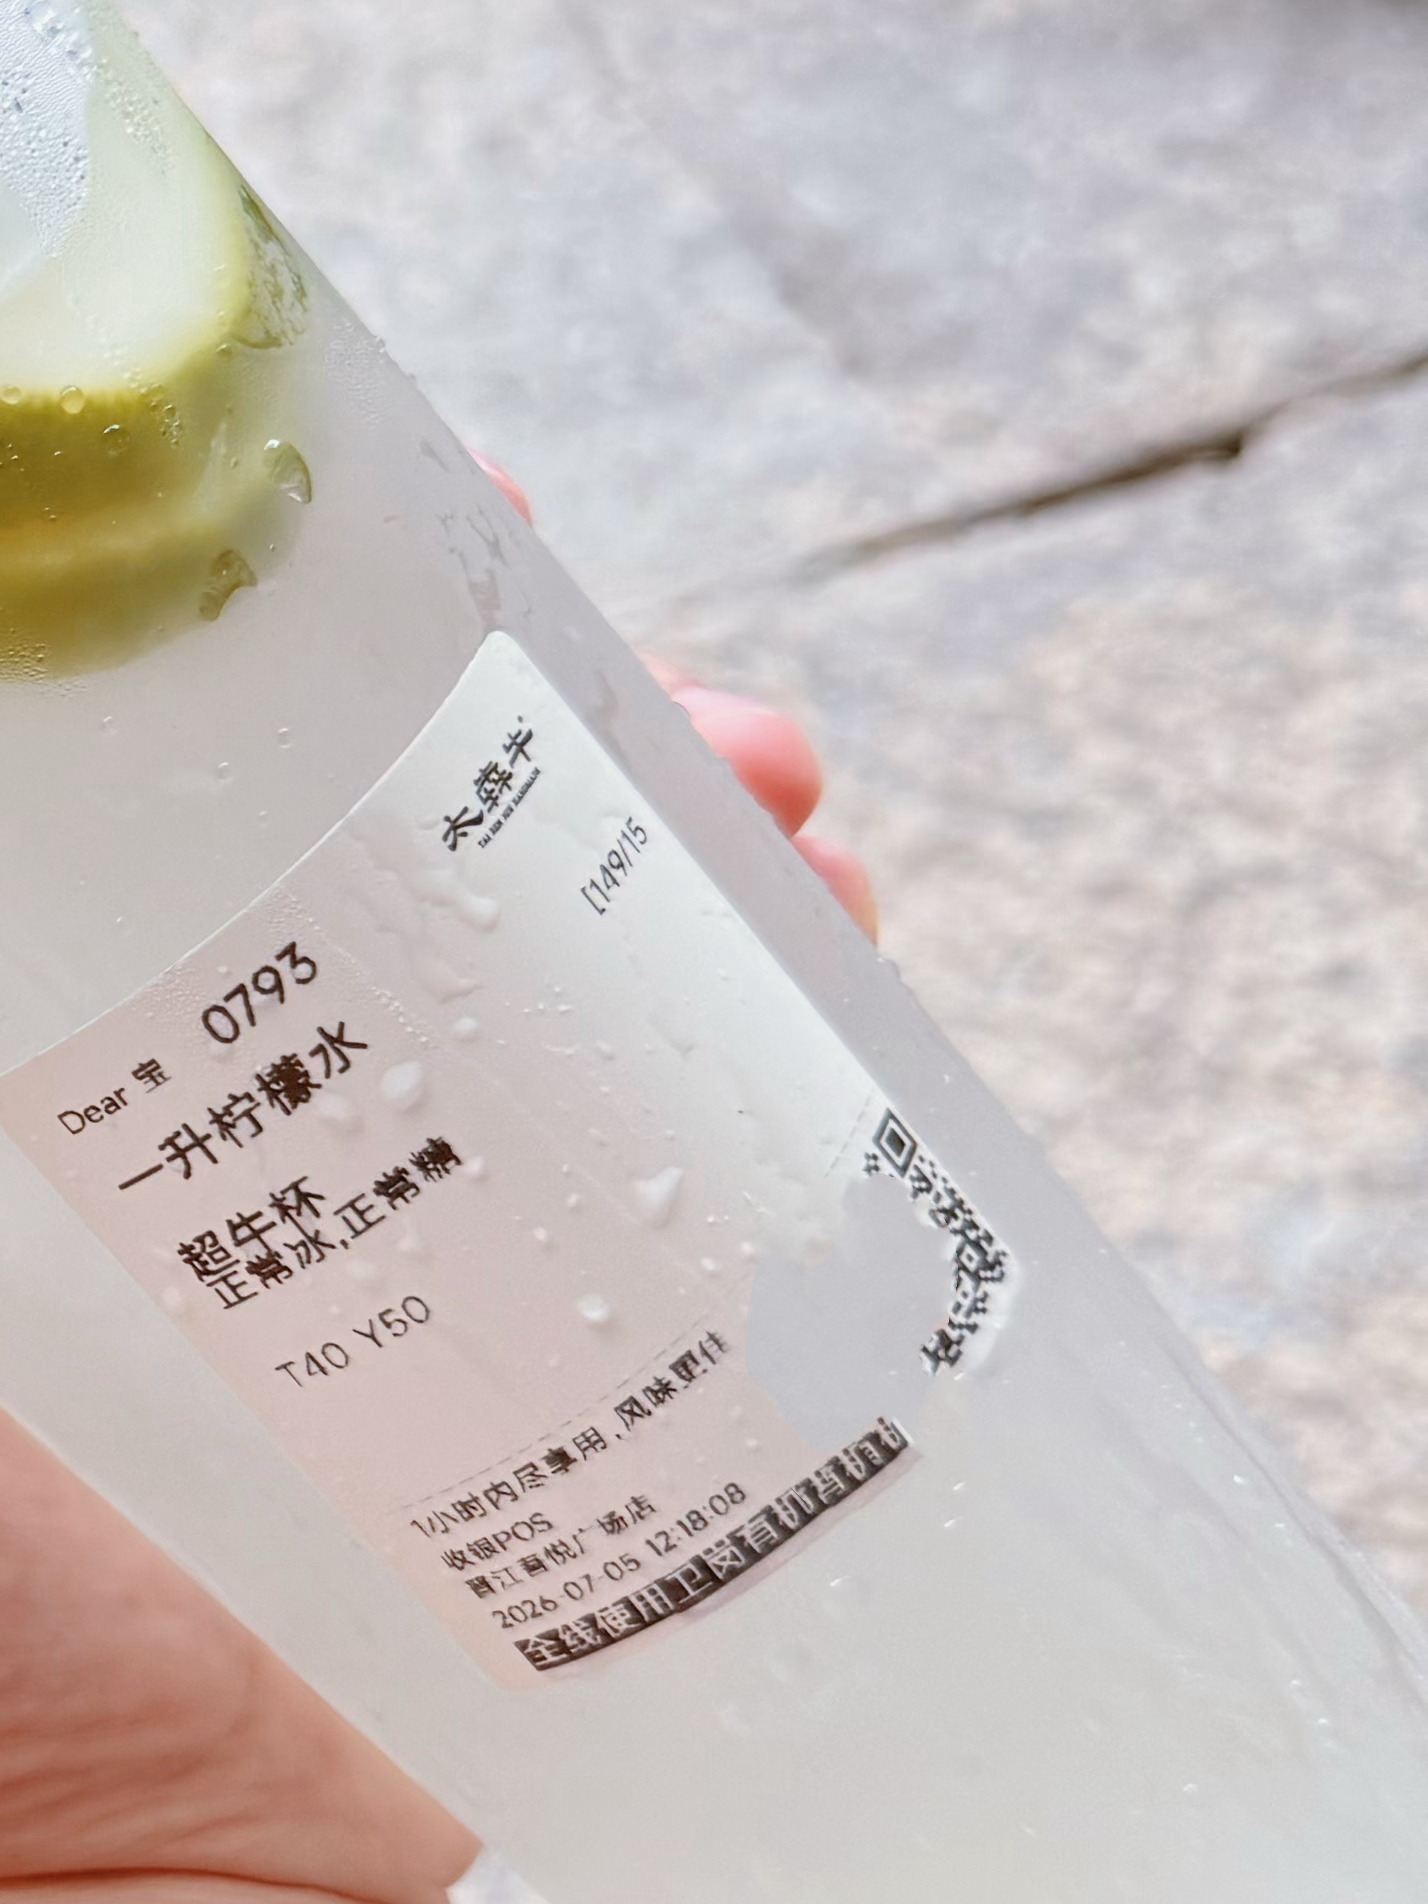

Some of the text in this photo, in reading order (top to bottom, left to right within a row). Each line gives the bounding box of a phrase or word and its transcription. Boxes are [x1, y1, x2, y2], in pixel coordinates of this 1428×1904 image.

[57, 1087, 129, 1136] Dear
[201, 941, 318, 1044] 0793
[118, 1021, 369, 1191] 一升柠檬水
[177, 1176, 326, 1282] 超牛杯
[275, 1295, 430, 1388] T40 Y50
[441, 1512, 555, 1573] 收银POS
[492, 1482, 747, 1630] 2026-07-05 12:18:08
